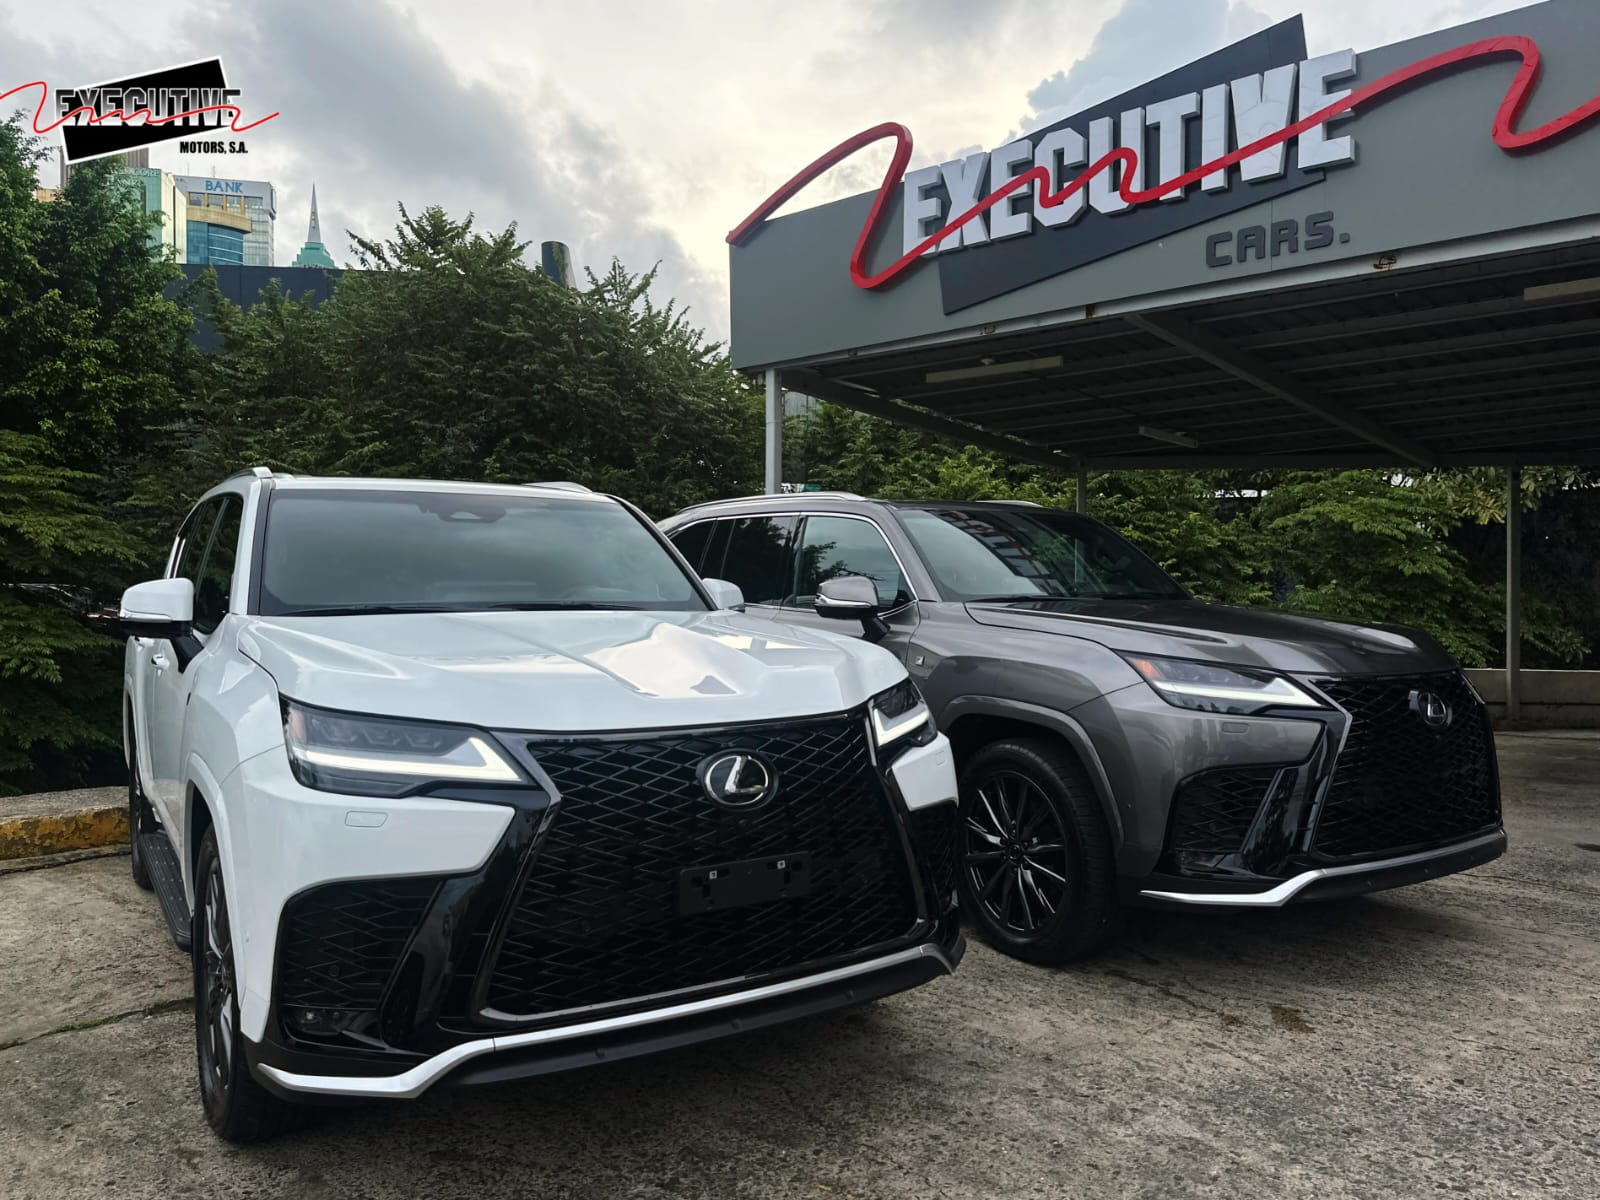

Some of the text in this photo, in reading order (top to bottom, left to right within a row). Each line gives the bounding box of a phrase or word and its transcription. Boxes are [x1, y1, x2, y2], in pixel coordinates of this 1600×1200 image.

[903, 48, 1357, 257] EXECUTIVE
[205, 180, 244, 193] BANK
[1206, 211, 1351, 268] CARS.
